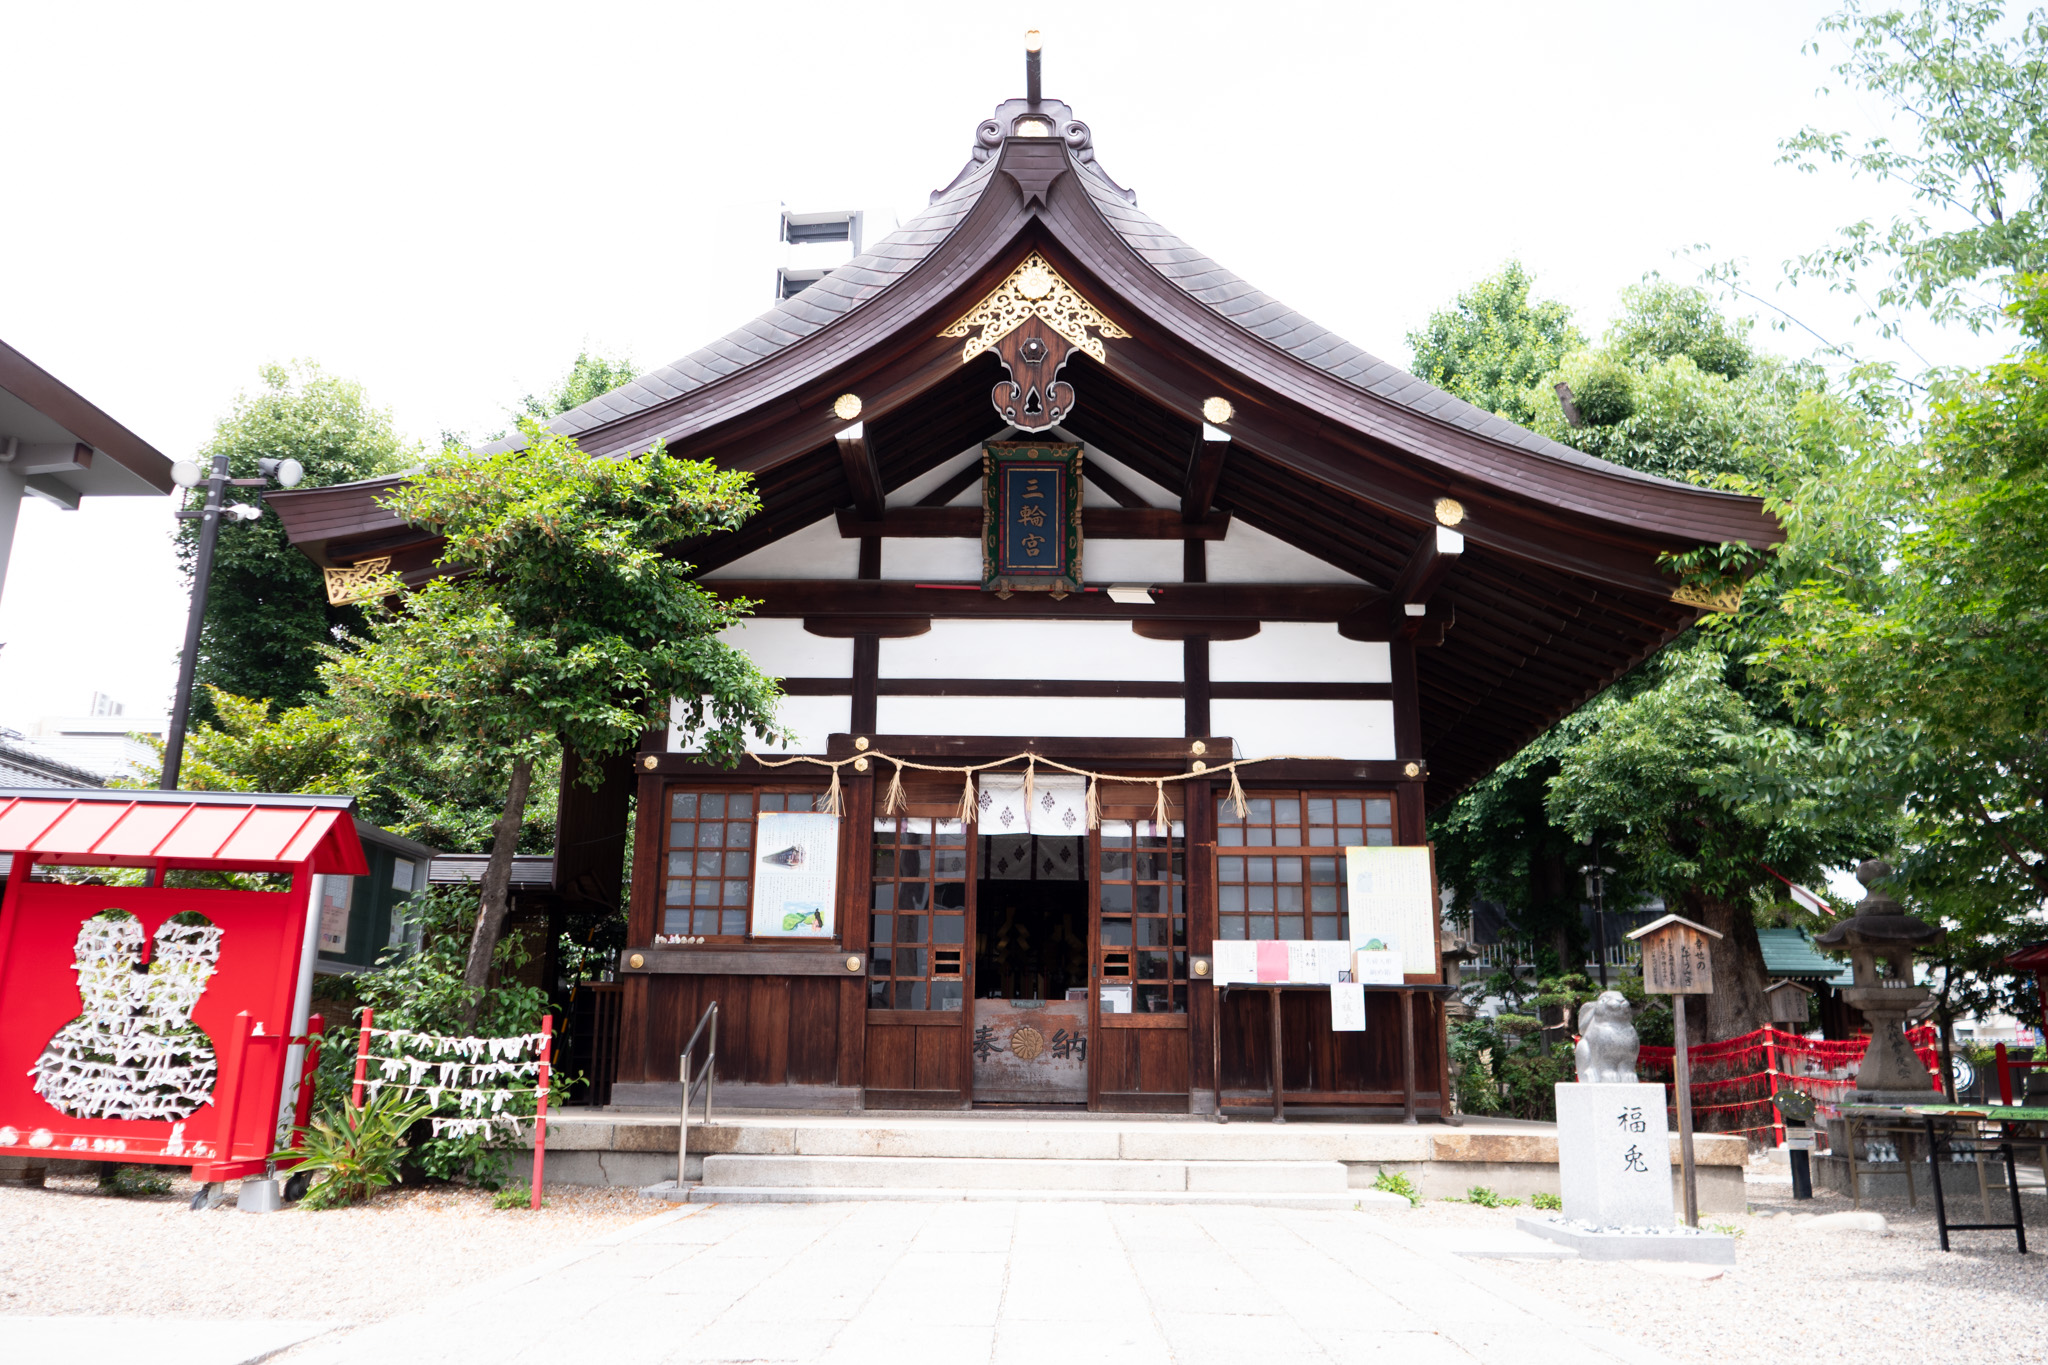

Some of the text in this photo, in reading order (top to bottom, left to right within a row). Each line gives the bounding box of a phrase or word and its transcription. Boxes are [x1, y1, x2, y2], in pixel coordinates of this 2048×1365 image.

[1017, 479, 1047, 557] 三輪宮
[1694, 938, 1706, 971] 幸せの
